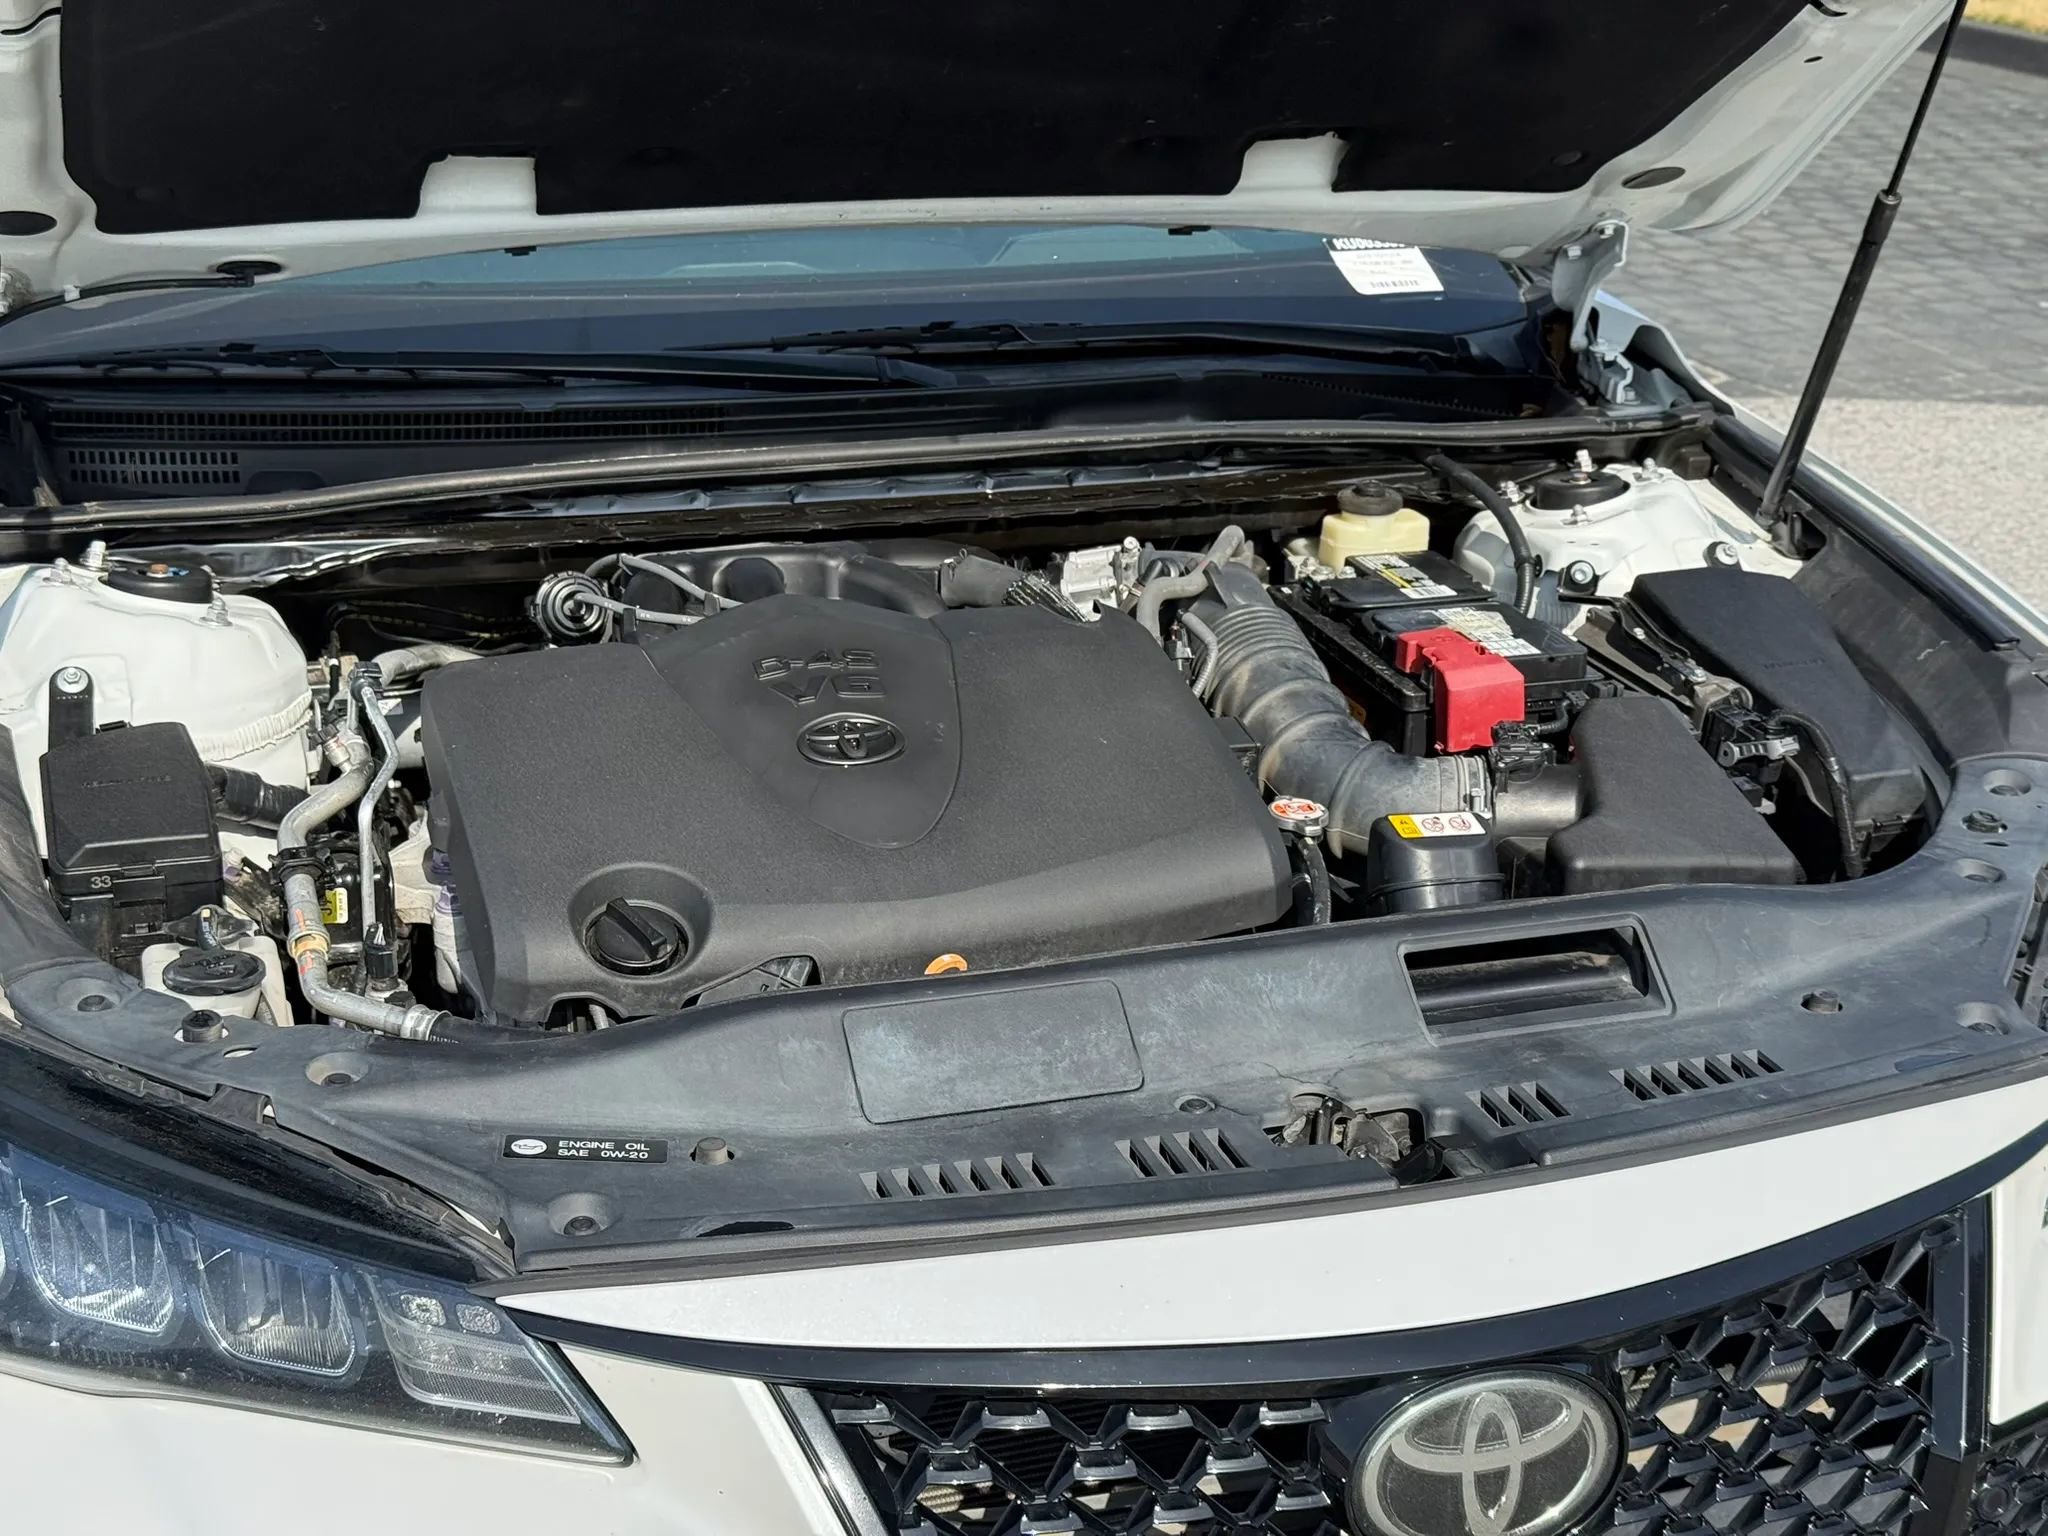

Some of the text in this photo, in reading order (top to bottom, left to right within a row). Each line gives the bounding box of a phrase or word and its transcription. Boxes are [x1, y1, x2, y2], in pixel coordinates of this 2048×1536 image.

[767, 673, 888, 705] V6
[90, 875, 113, 889] 33
[558, 1140, 650, 1151] ENGINE OIL
[557, 1149, 649, 1159] SAE 0W-20
